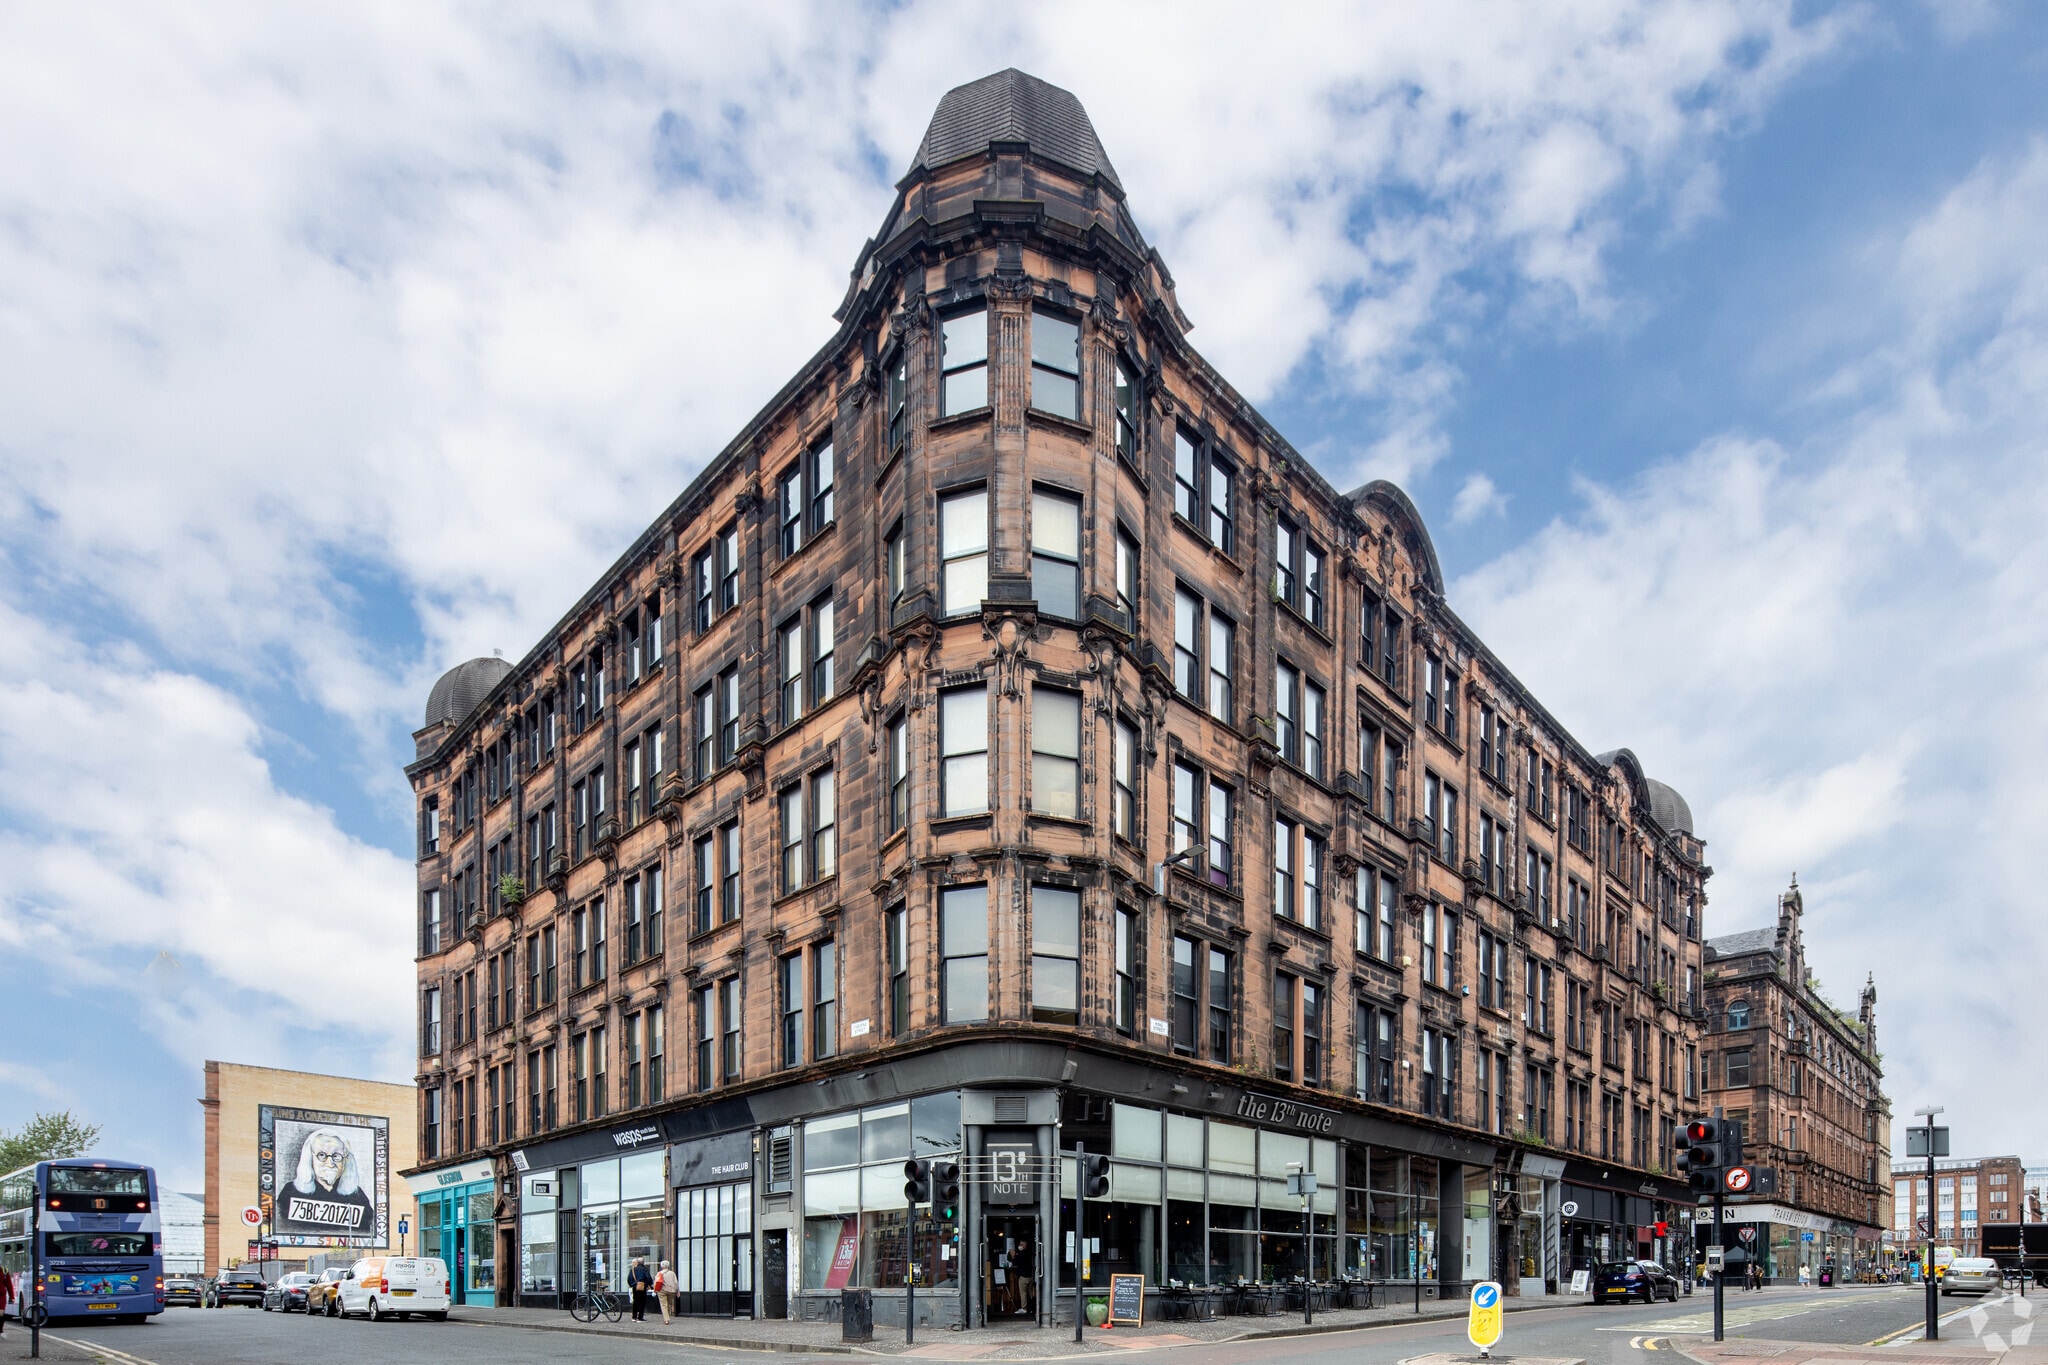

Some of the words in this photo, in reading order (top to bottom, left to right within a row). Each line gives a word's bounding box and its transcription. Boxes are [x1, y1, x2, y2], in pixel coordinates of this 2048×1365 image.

[343, 1114, 353, 1124] IN
[355, 1115, 372, 1127] THE
[1237, 1095, 1267, 1119] the
[1269, 1101, 1296, 1123] 13th
[1296, 1111, 1332, 1132] note
[613, 1128, 643, 1148] wasps
[261, 1127, 273, 1191] CONNOLLY
[711, 1165, 721, 1175] THE
[721, 1163, 734, 1173] HAIR
[735, 1161, 749, 1171] CLUB
[377, 1179, 387, 1196] THE
[993, 1183, 1028, 1194] NOTE
[95, 1198, 106, 1209] 10
